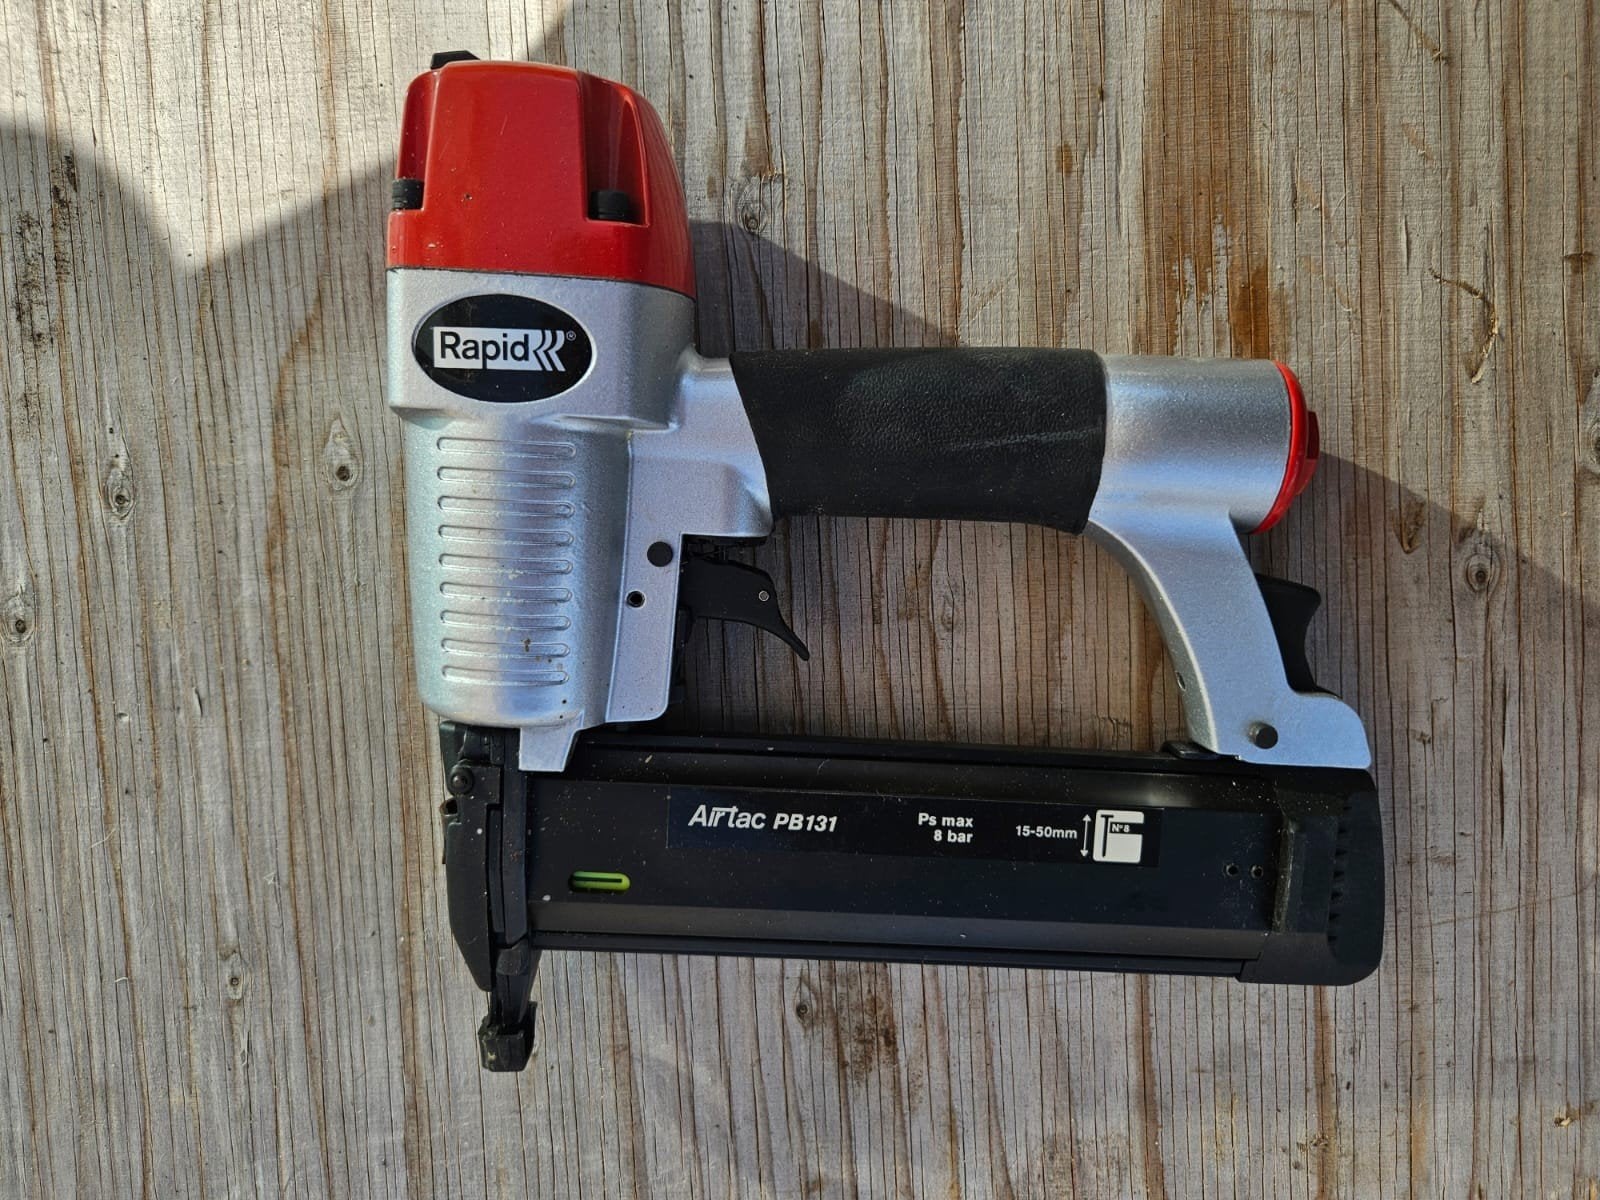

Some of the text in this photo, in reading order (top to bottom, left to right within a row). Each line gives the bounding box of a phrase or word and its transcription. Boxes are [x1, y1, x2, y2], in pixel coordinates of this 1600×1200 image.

[440, 331, 530, 370] Rapid
[688, 804, 838, 833] Airtac PB131
[918, 812, 974, 828] Ps max
[933, 829, 974, 843] 8 bar
[1015, 825, 1078, 840] 15-50mm
